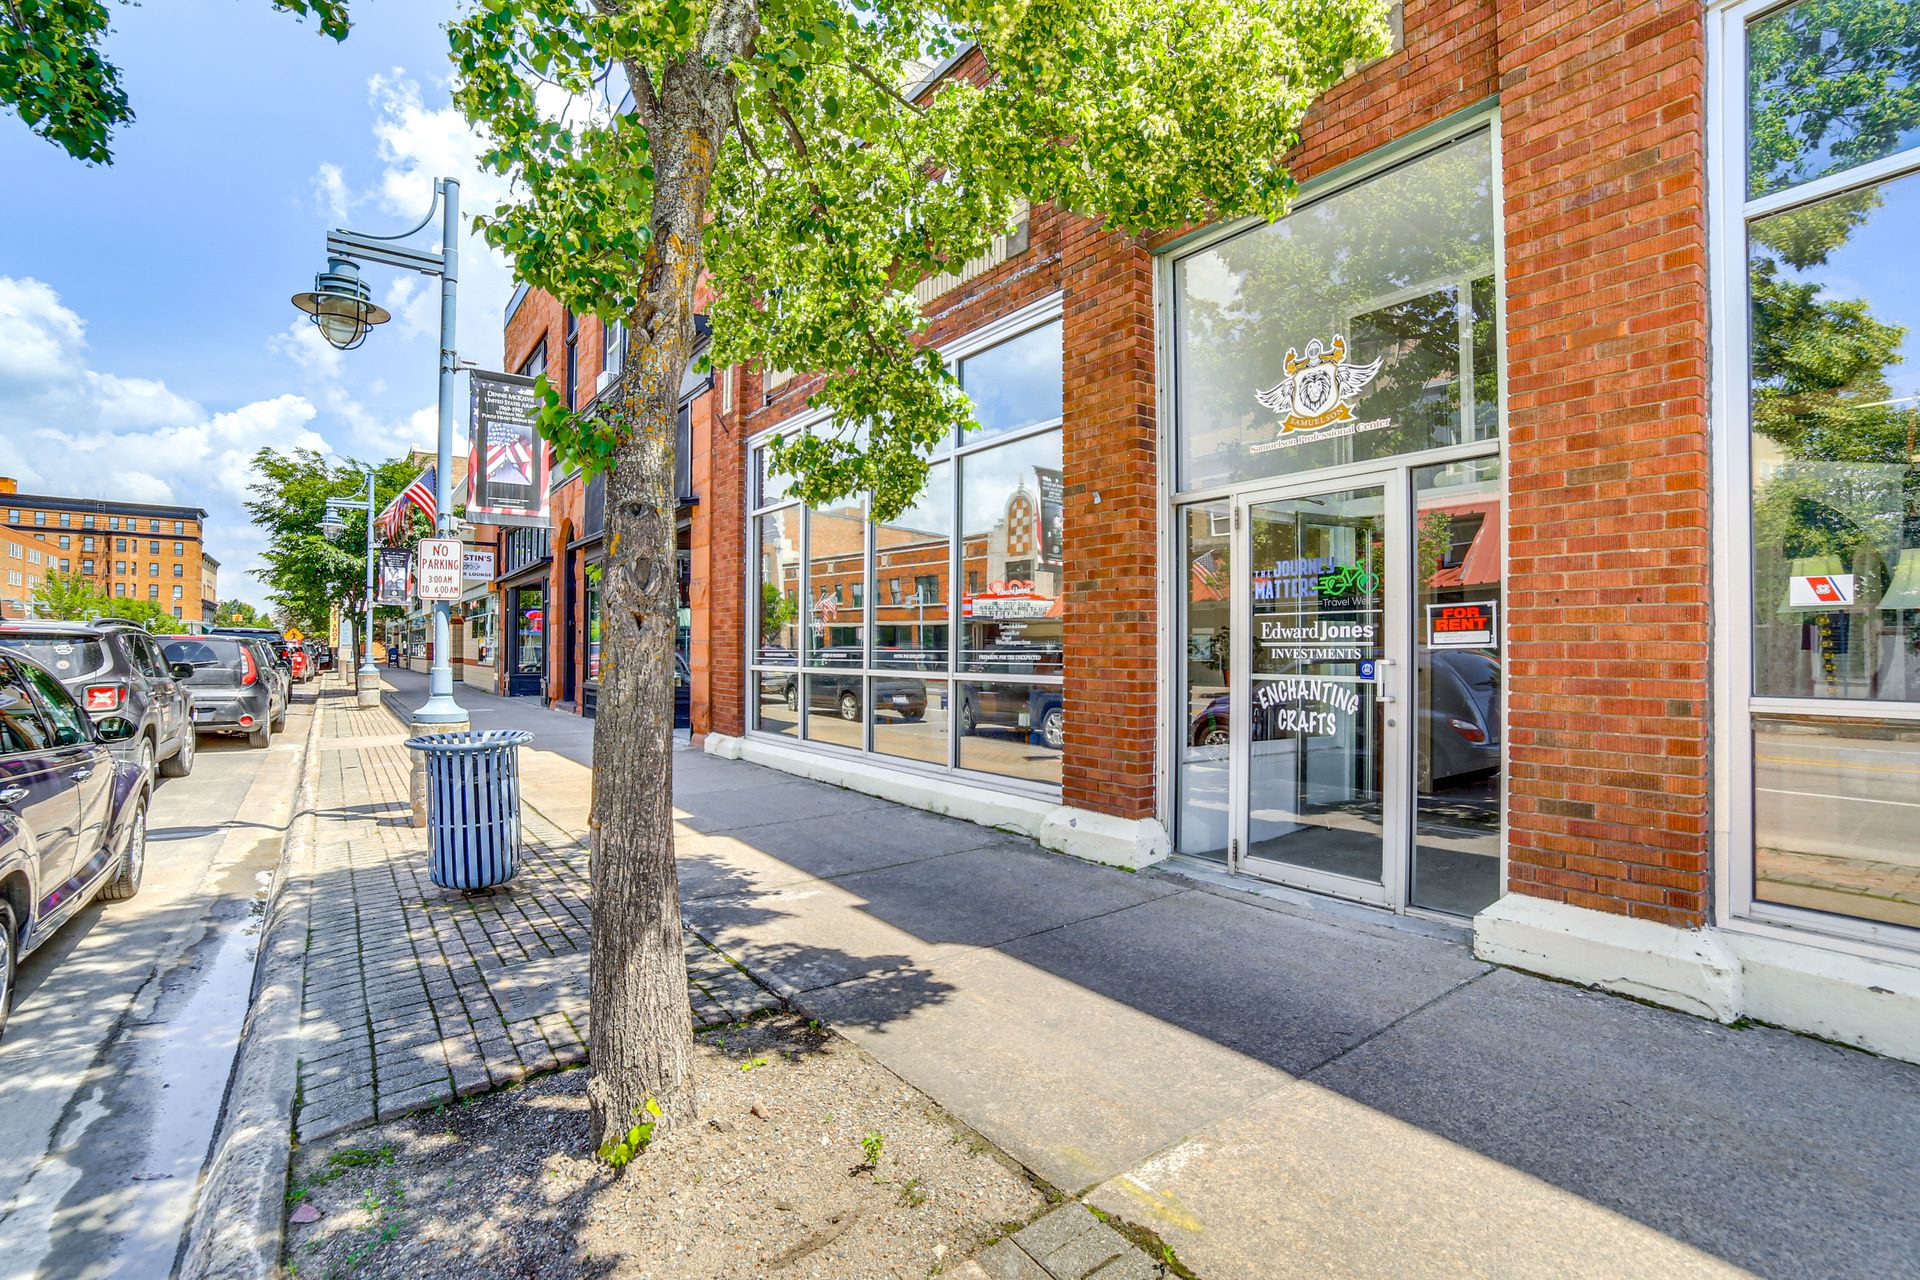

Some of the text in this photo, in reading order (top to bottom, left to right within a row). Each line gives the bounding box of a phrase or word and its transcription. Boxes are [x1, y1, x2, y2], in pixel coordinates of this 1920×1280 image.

[484, 397, 504, 405] UNITED
[1289, 408, 1344, 426] SAMUELSON
[1249, 417, 1392, 454] Samuelson Professional Center
[432, 545, 449, 557] NO
[421, 558, 459, 570] PARKING
[463, 554, 492, 562] STIN'S
[1254, 555, 1335, 578] THE JOURNEY
[428, 575, 453, 584] 3:00 AM
[421, 585, 430, 593] TO
[434, 585, 449, 594] 6:00
[1254, 577, 1319, 600] MATTERS
[1323, 596, 1350, 607] Travel
[1441, 606, 1480, 618] FOR
[1435, 617, 1488, 632] RENT
[1271, 647, 1362, 660] INVESTMENTS
[1257, 678, 1360, 715] ENCHANTING
[1277, 708, 1337, 736] CRAFTS
